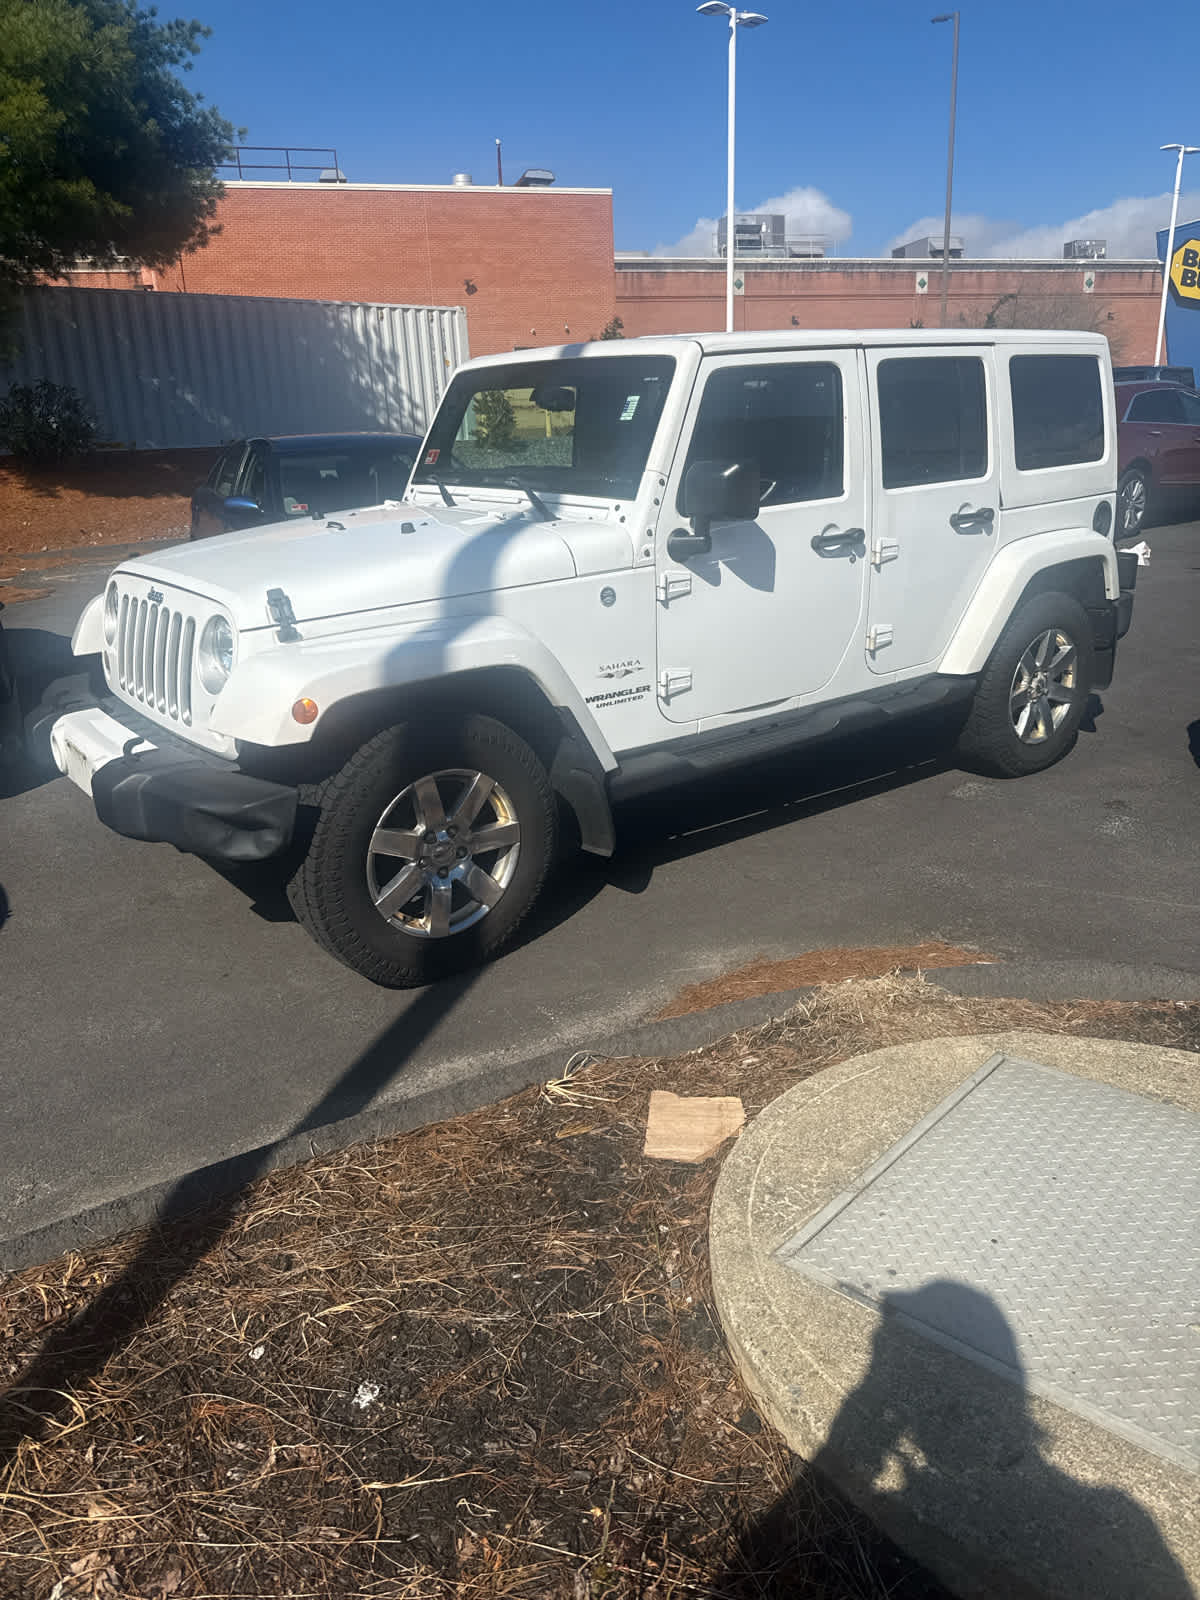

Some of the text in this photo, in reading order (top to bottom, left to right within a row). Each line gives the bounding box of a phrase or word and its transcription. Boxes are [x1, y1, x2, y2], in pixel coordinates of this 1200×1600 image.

[1182, 248, 1200, 269] B
[1180, 268, 1200, 288] B
[599, 660, 641, 672] SAHARA
[585, 685, 651, 704] WRANGLER
[596, 695, 644, 708] UNLIMITED
